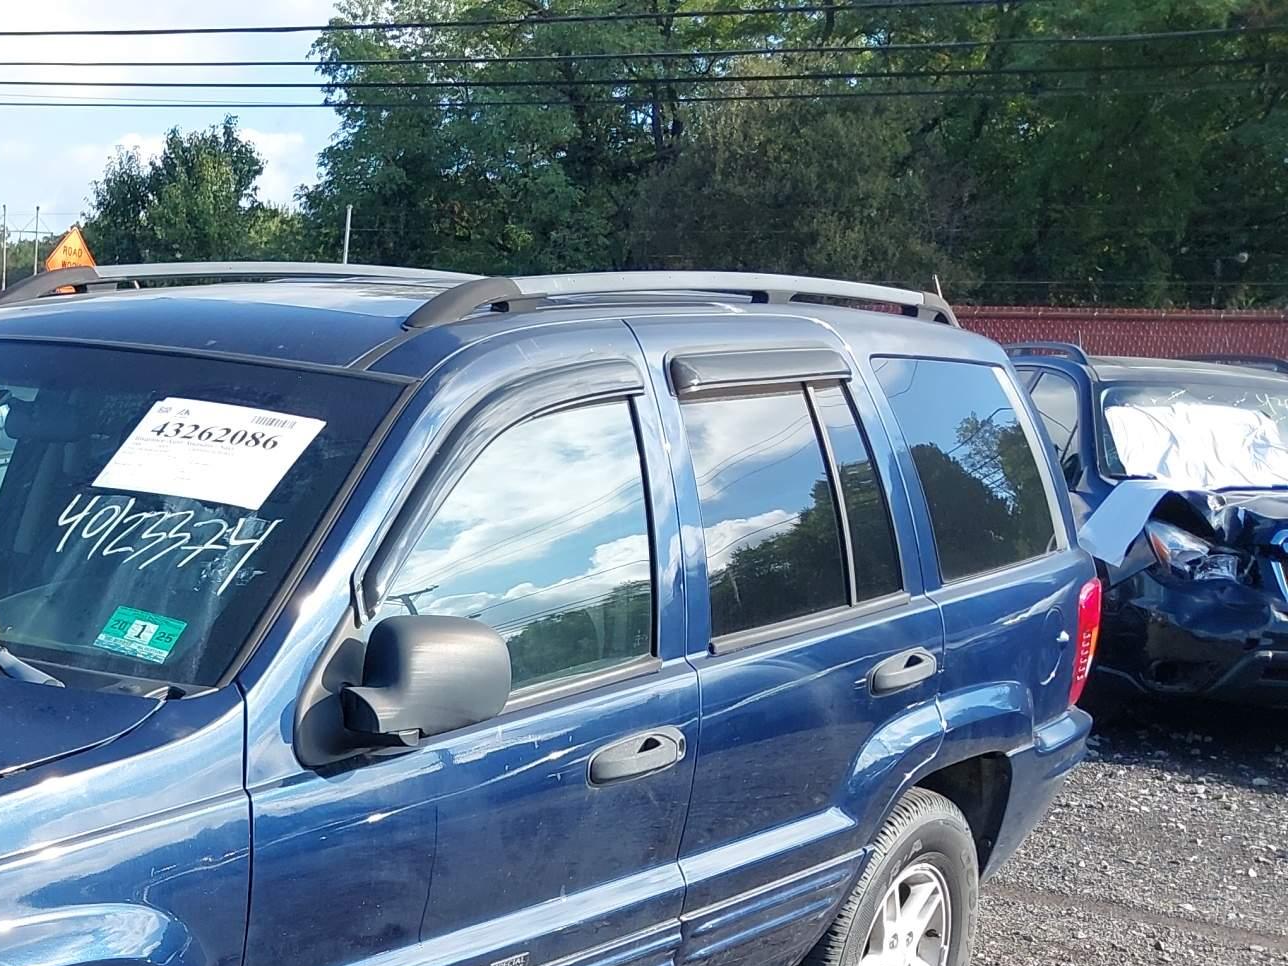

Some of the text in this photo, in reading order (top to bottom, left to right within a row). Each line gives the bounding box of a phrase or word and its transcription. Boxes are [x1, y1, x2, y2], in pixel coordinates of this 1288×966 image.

[63, 246, 83, 258] ROAD
[150, 421, 281, 450] 43262086
[133, 623, 147, 640] 1
[154, 630, 174, 644] 25
